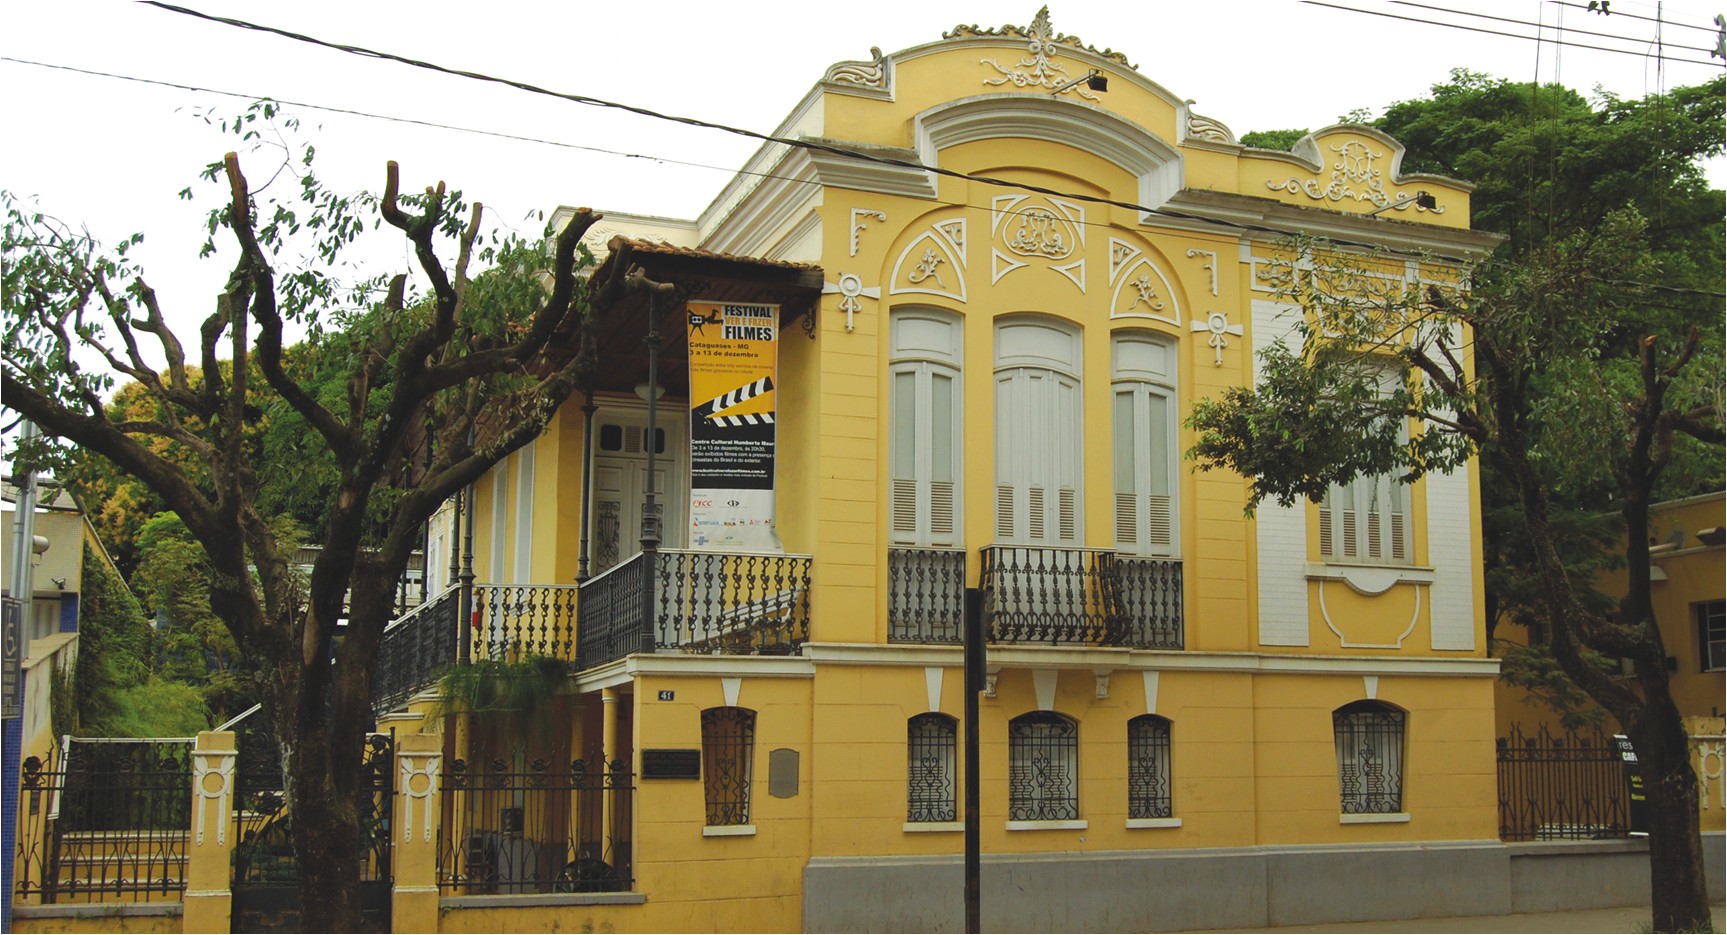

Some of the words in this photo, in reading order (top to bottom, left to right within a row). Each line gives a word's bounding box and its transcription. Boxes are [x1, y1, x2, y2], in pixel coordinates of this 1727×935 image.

[725, 305, 772, 318] FESTIVAL
[725, 317, 740, 325] VER
[742, 318, 747, 326] E
[748, 318, 772, 327] FAZER
[725, 326, 772, 341] FILMES
[660, 691, 672, 700] 41
